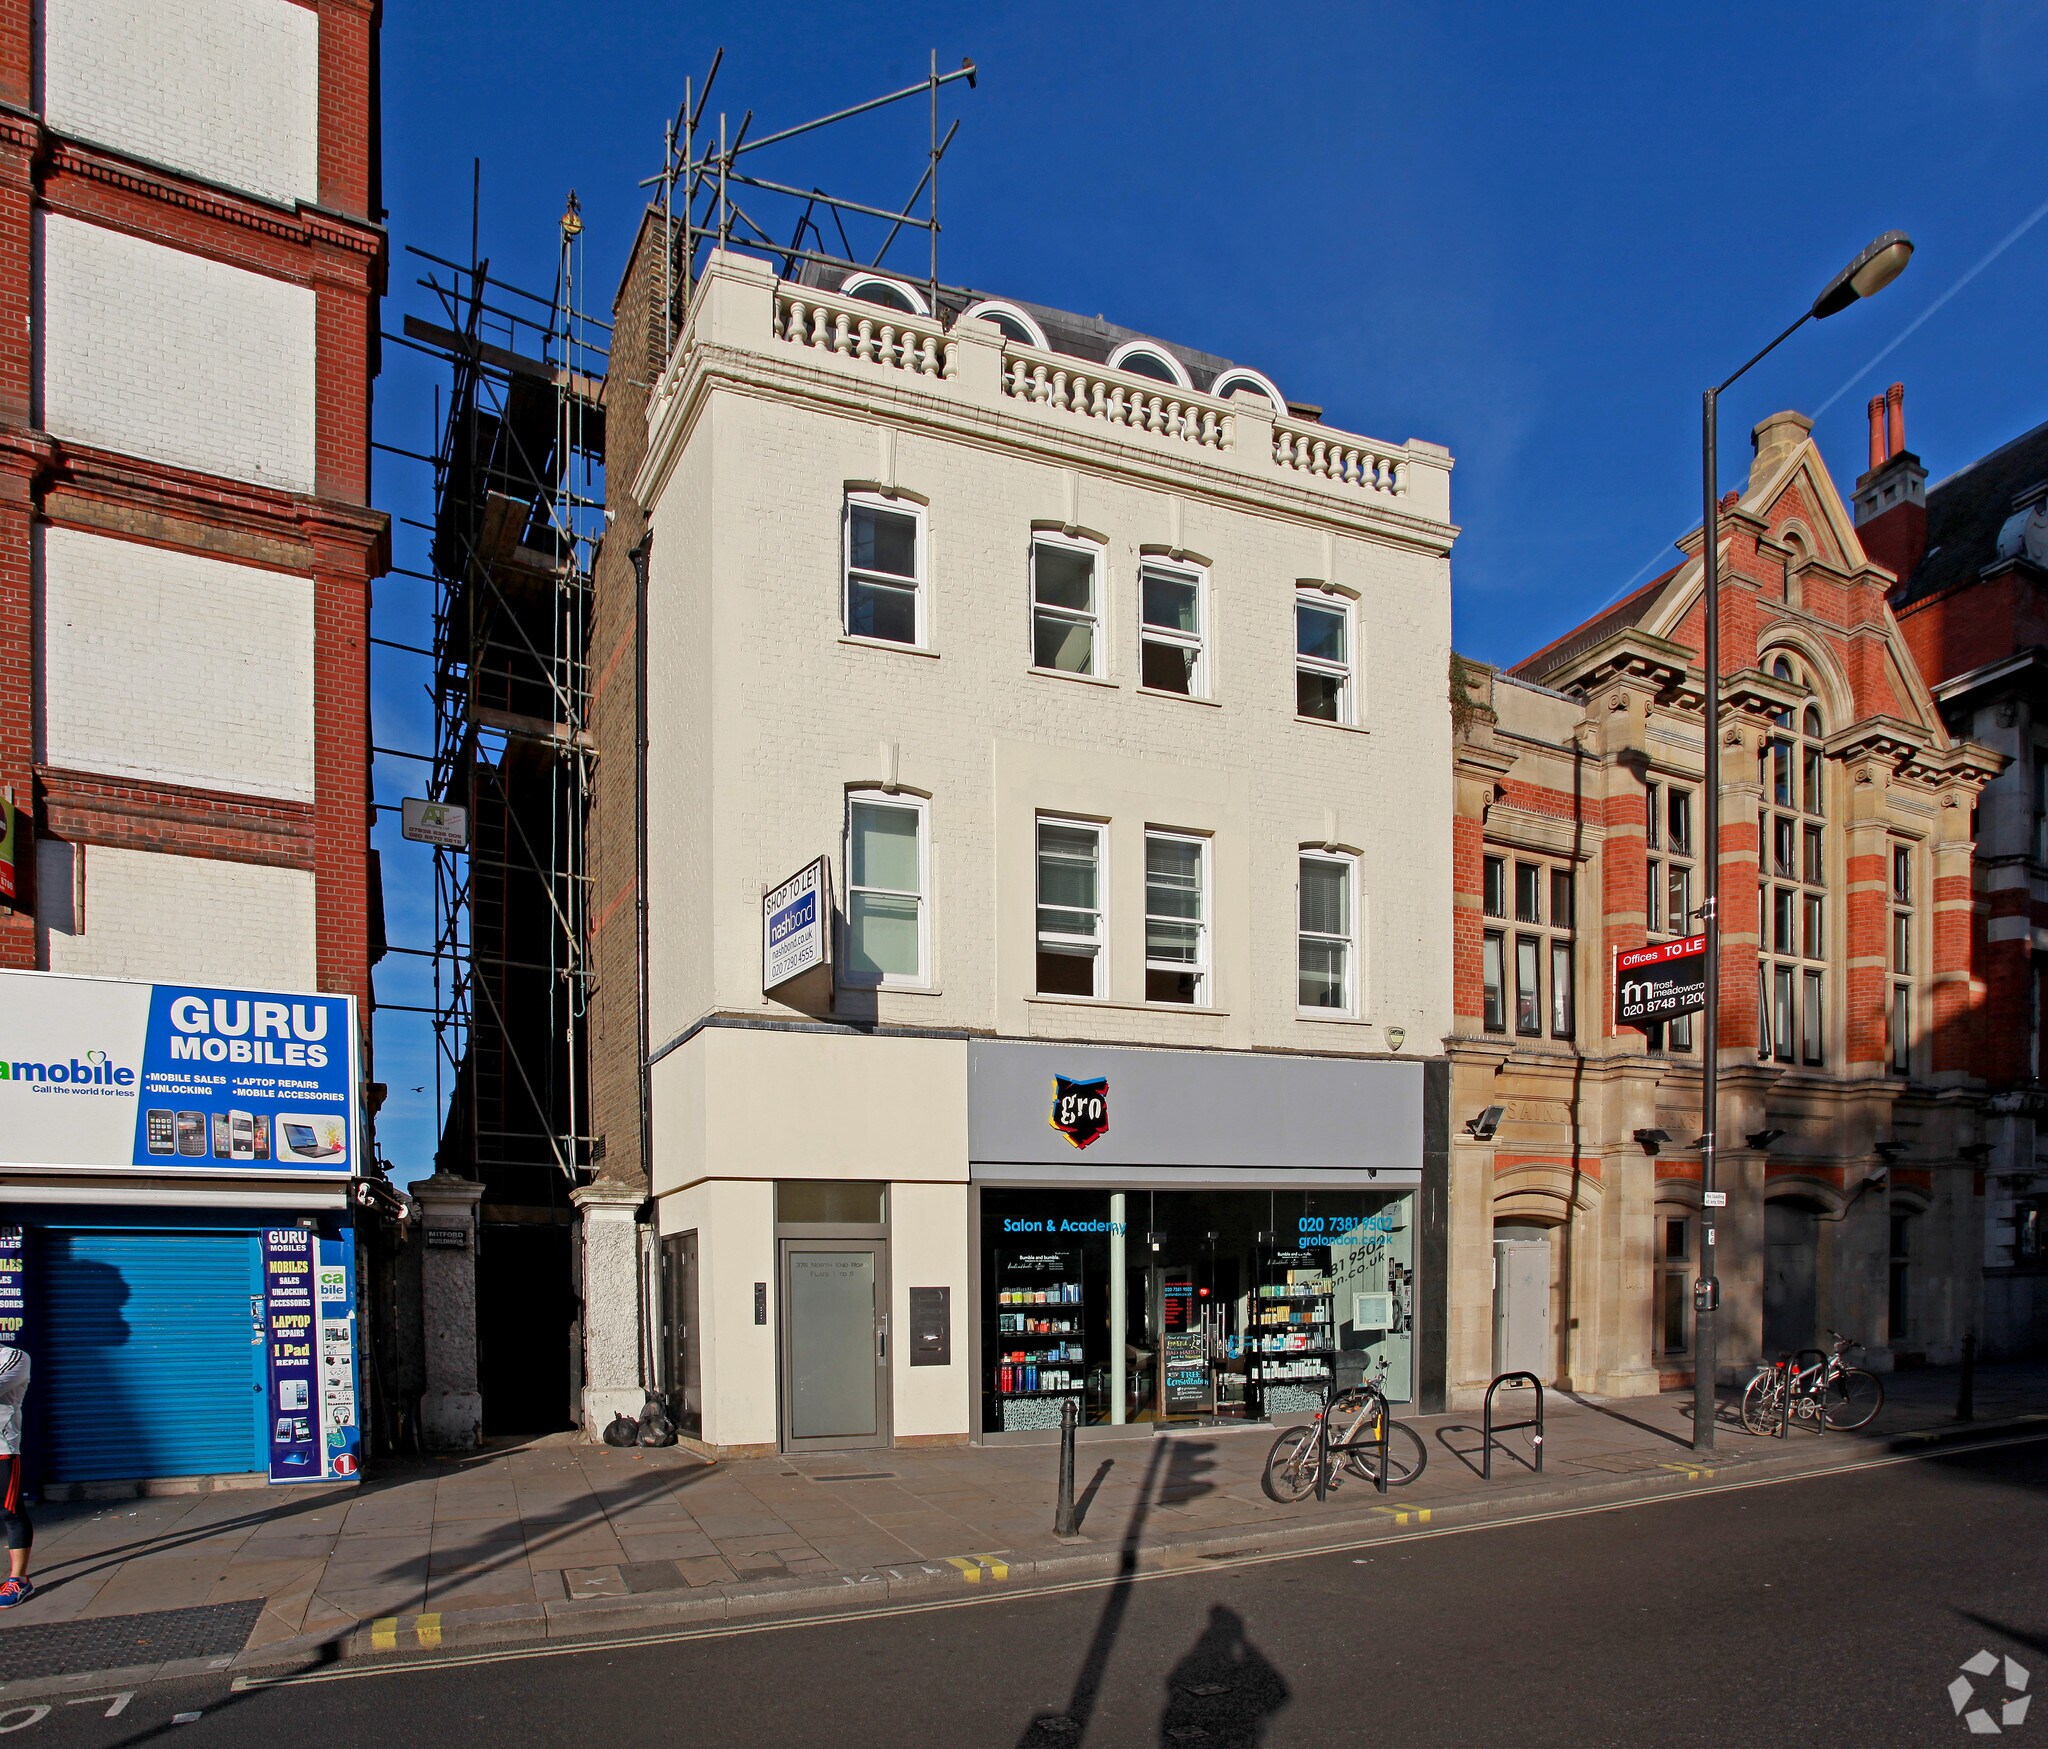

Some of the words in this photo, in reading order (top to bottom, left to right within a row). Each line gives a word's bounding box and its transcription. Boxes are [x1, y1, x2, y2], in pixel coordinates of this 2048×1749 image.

[766, 887, 787, 916] SHOP
[789, 881, 800, 901] TO
[802, 865, 818, 892] LET
[771, 897, 814, 943] nashbond
[772, 928, 813, 960] nashbond.co.uk
[1622, 951, 1658, 966] Offices
[1664, 943, 1682, 957] TO
[1685, 938, 1705, 953] LE
[771, 962, 783, 978] 020
[784, 954, 798, 974] 7290
[798, 945, 814, 963] 4555
[1653, 980, 1673, 990] frost
[1653, 981, 1705, 998] meadowcro
[1621, 980, 1653, 1005] fm
[1623, 1003, 1644, 1017] 020
[1647, 997, 1676, 1012] 8748
[170, 995, 328, 1042] GURU
[170, 1035, 329, 1068] MOBILES
[0, 1058, 136, 1086] amobile
[149, 1072, 191, 1083] MOBILE
[193, 1074, 227, 1085] SALES
[150, 1084, 213, 1095] UNLOCKING
[236, 1077, 276, 1087] LAPTOP
[278, 1079, 319, 1089] REPAIRS
[32, 1084, 52, 1094] Call
[53, 1086, 70, 1095] the
[72, 1087, 99, 1096] world
[100, 1088, 115, 1096] for
[115, 1089, 135, 1097] less
[236, 1088, 275, 1099] MOBILE
[277, 1090, 345, 1101] ACCESSORIES
[1060, 1093, 1102, 1125] gro
[1506, 1101, 1569, 1123] SAINT
[1003, 1218, 1042, 1232] Salon
[1046, 1219, 1056, 1232] &
[1060, 1218, 1127, 1236] Academy
[1298, 1217, 1324, 1233] 020
[1329, 1217, 1358, 1232] 7381
[1363, 1216, 1393, 1231] 9502
[268, 1231, 308, 1244] GURU
[428, 1231, 464, 1239] MITFORD
[1298, 1233, 1393, 1249] grolondon.co.uk
[0, 1241, 22, 1249] ILES
[270, 1244, 307, 1252] MOBILES
[0, 1258, 23, 1272] ILES
[269, 1260, 309, 1274] MOBILES
[279, 1276, 300, 1285] SALES
[0, 1287, 21, 1297] CKING
[271, 1288, 308, 1296] UNLOCKING
[0, 1300, 24, 1308] SORES
[270, 1299, 311, 1307] ACCESSORES
[0, 1317, 23, 1331] TOP
[272, 1315, 311, 1329] LAPTOP
[0, 1332, 16, 1341] AIRS
[277, 1329, 305, 1338] REPAIRS
[284, 1343, 310, 1357] Pad
